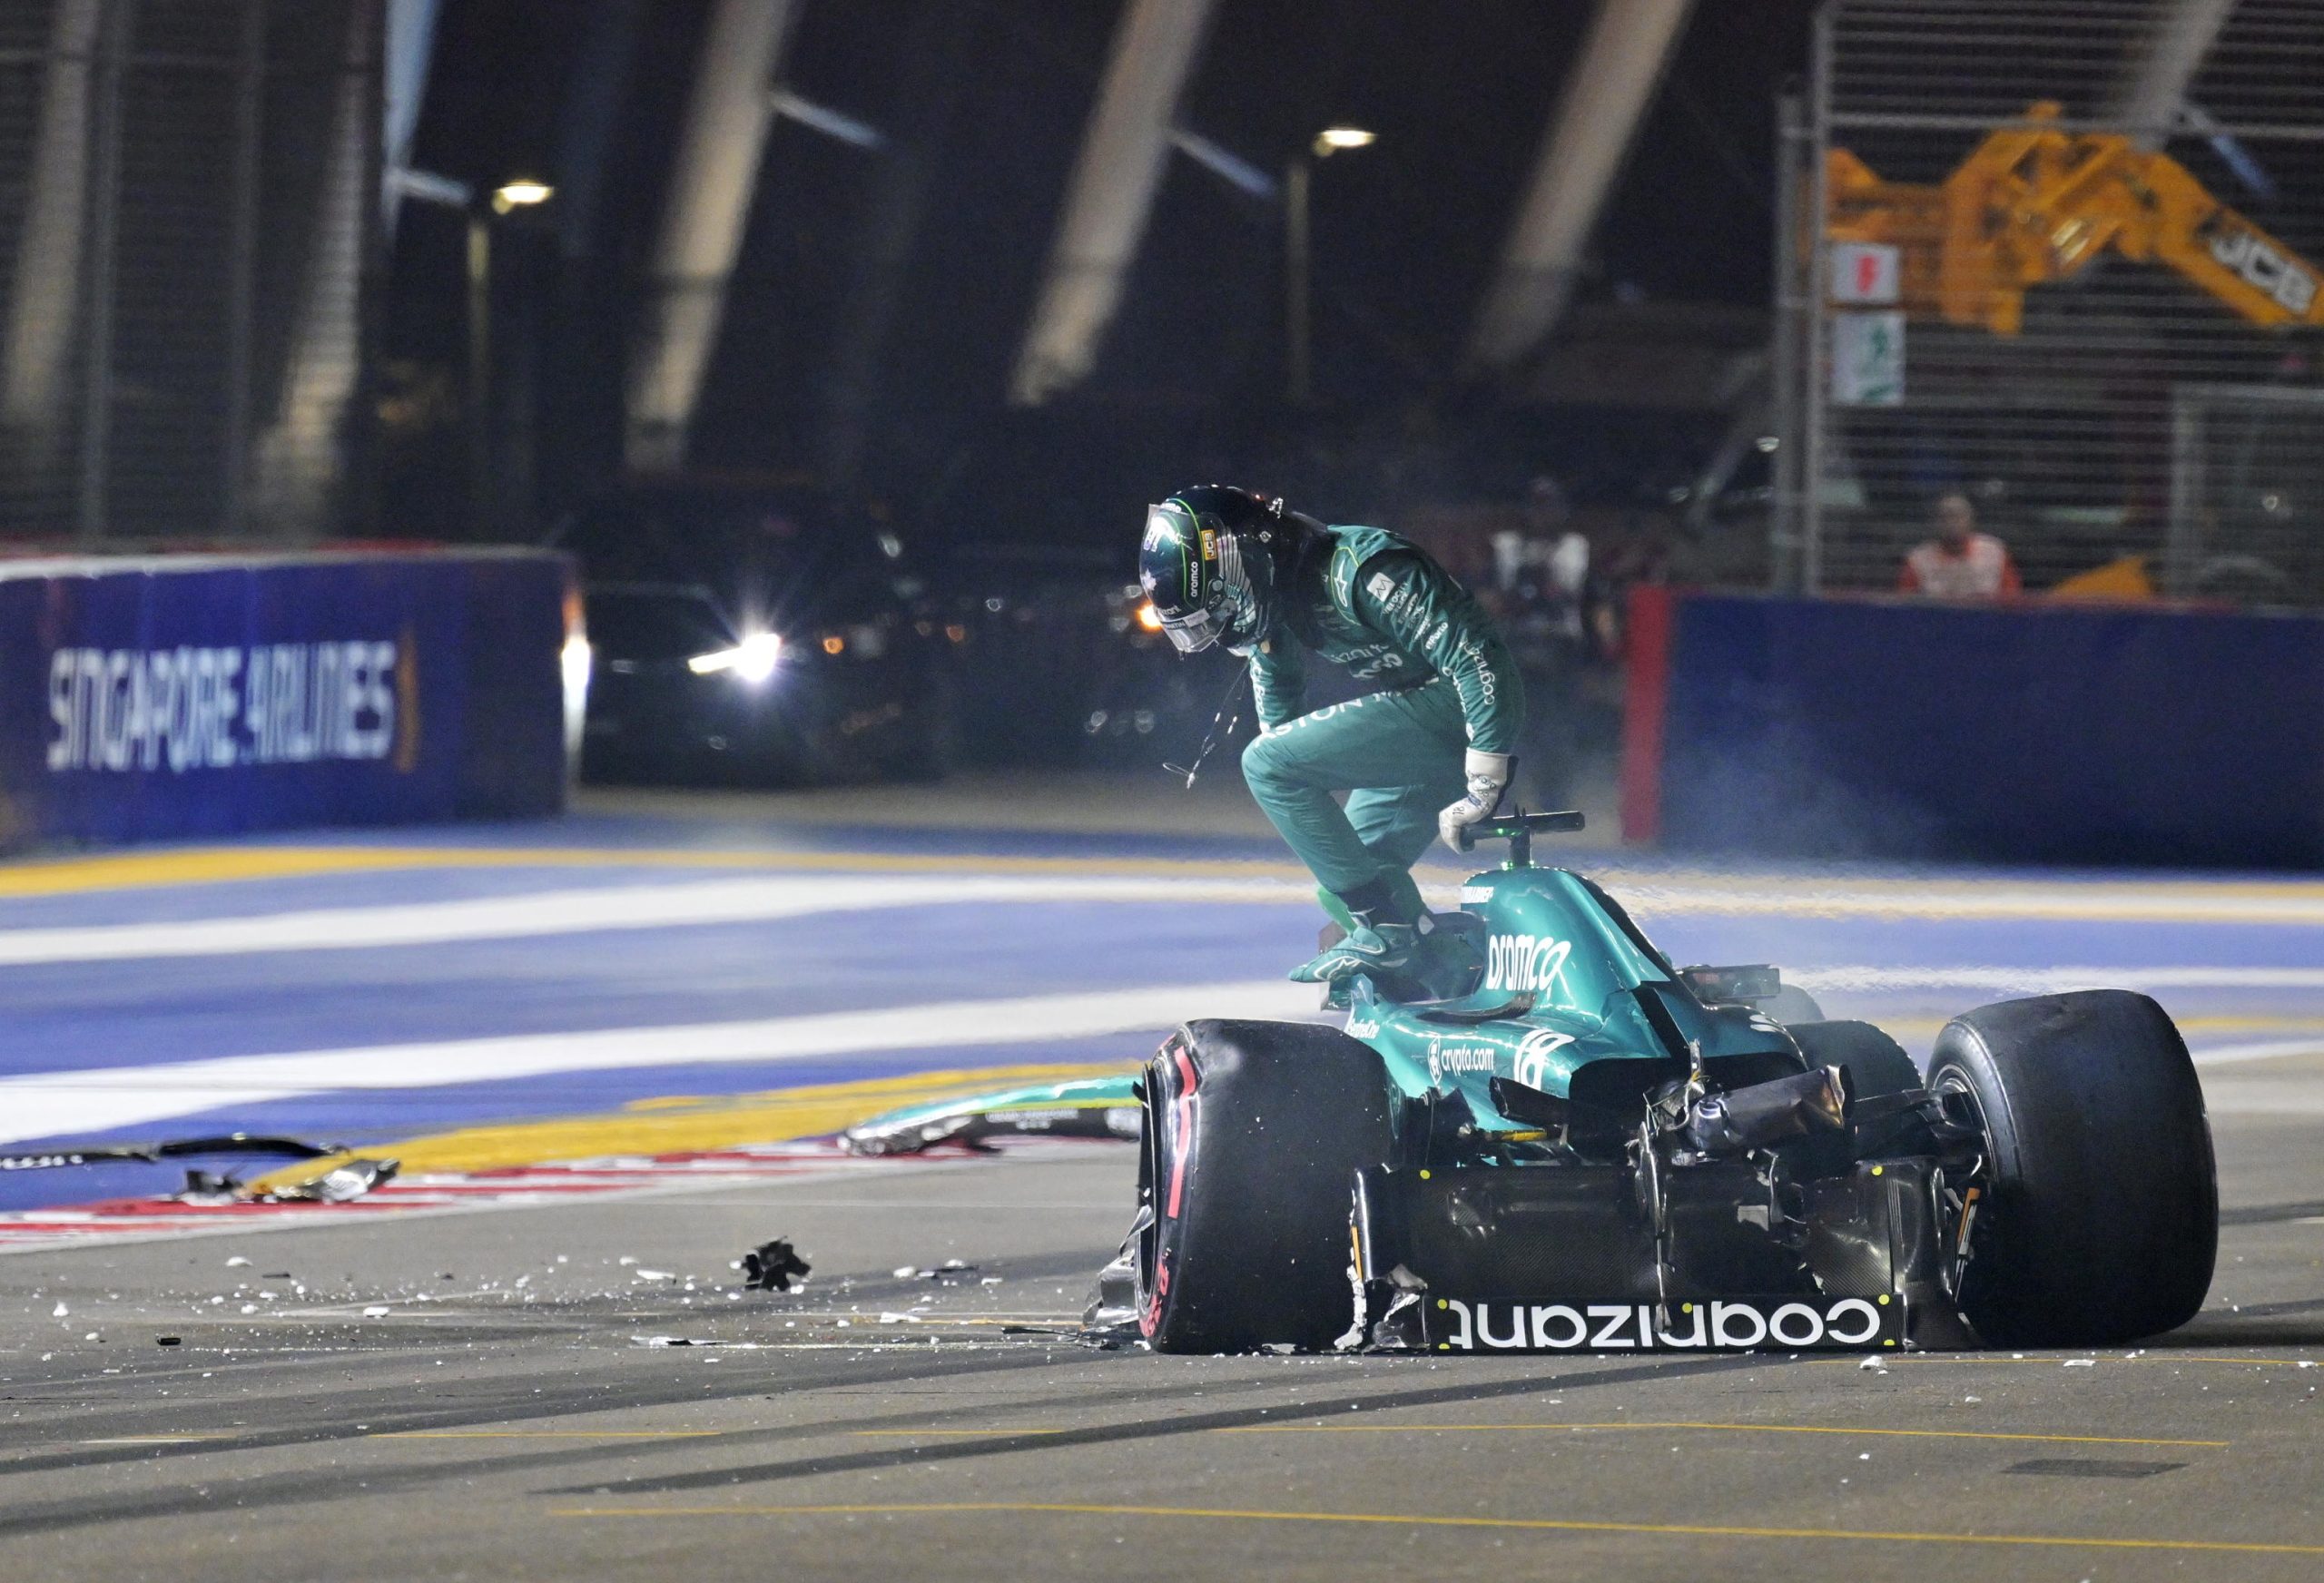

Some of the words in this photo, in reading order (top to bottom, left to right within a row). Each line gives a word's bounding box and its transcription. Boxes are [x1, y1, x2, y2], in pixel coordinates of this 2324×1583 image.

[2210, 232, 2317, 314] JCB
[1204, 532, 1216, 558] JCB
[1190, 560, 1199, 598] aramco
[47, 645, 241, 772] SINGAPORE
[245, 640, 398, 765] AIRLINES
[1486, 934, 1571, 991] aramco
[1441, 1044, 1495, 1077] crypto.com
